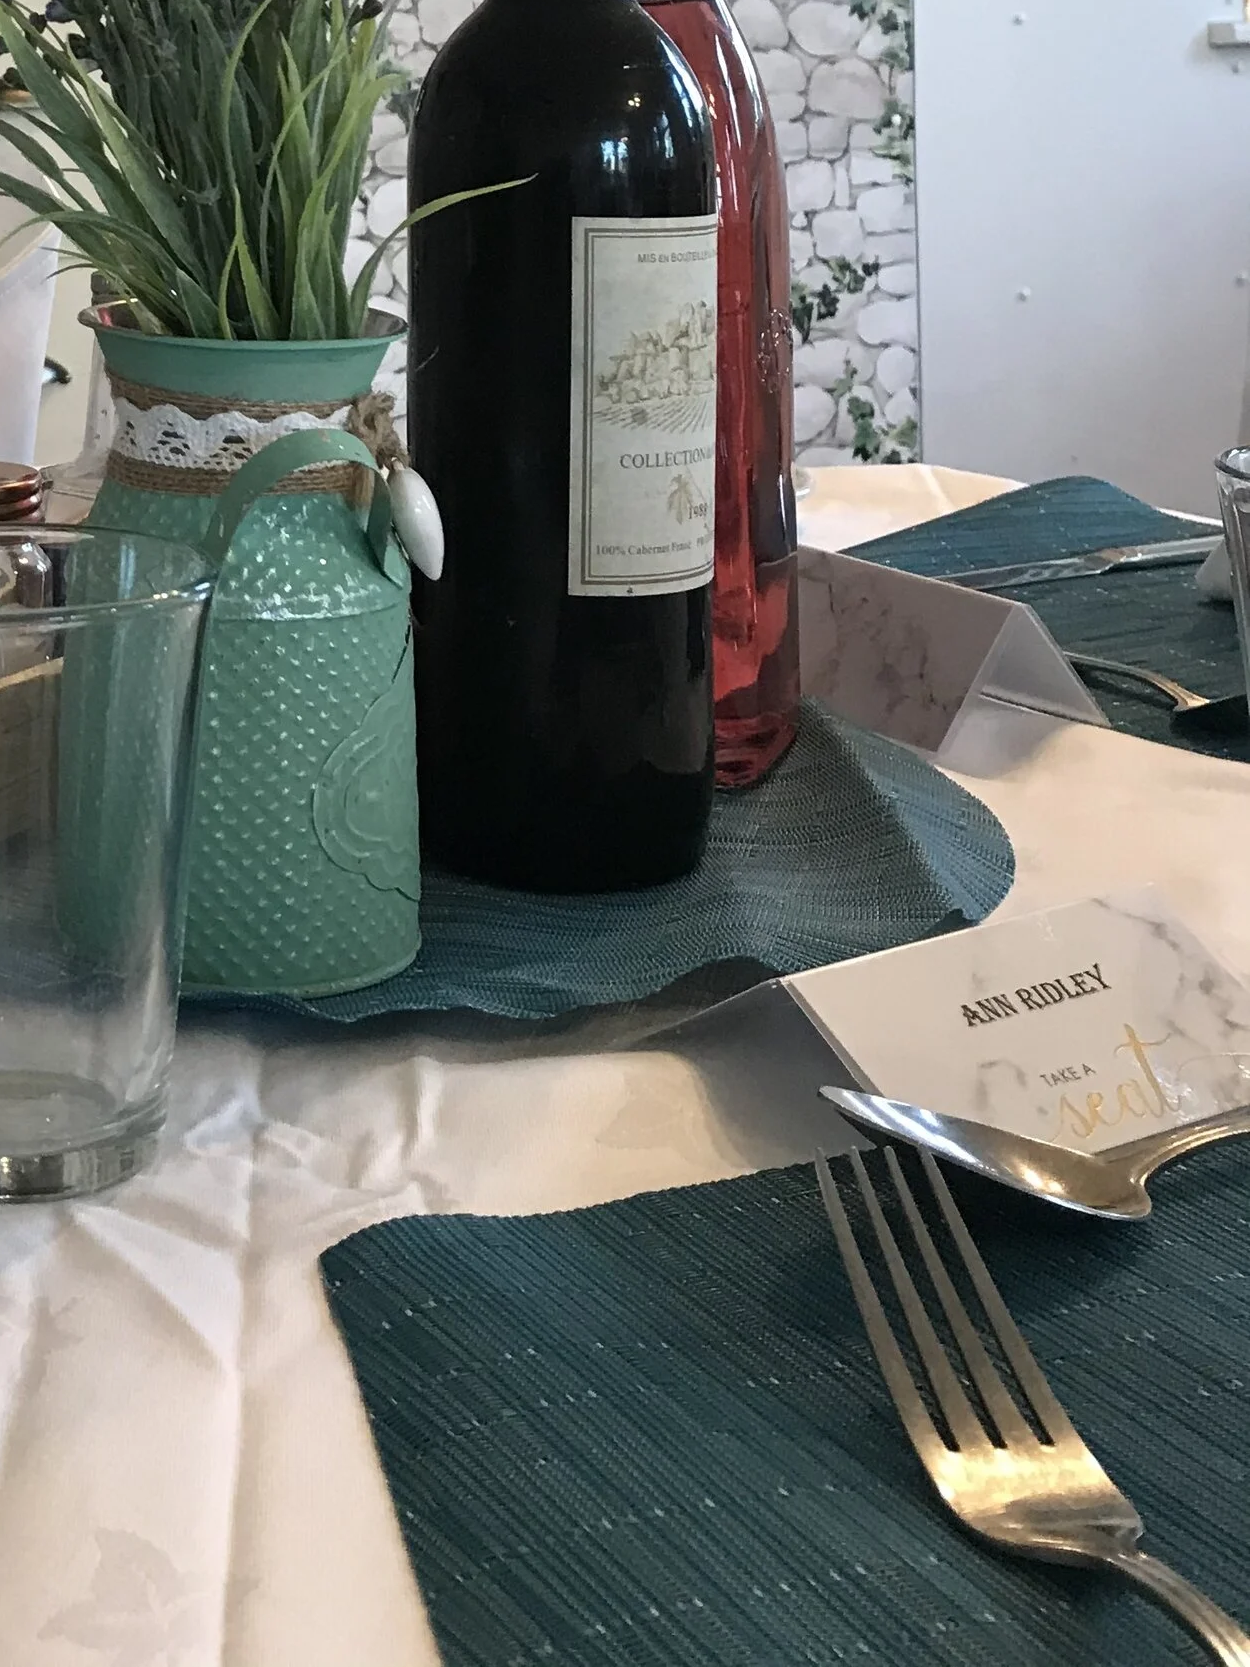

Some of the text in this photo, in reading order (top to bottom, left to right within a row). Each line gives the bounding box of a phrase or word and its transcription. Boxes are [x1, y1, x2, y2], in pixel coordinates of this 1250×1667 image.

[637, 252, 657, 263] MIS
[620, 448, 705, 468] COLLECTION
[961, 962, 1112, 1027] ANN RIDLEY
[1040, 1063, 1096, 1089] TAKE A
[1051, 1022, 1182, 1140] seat
